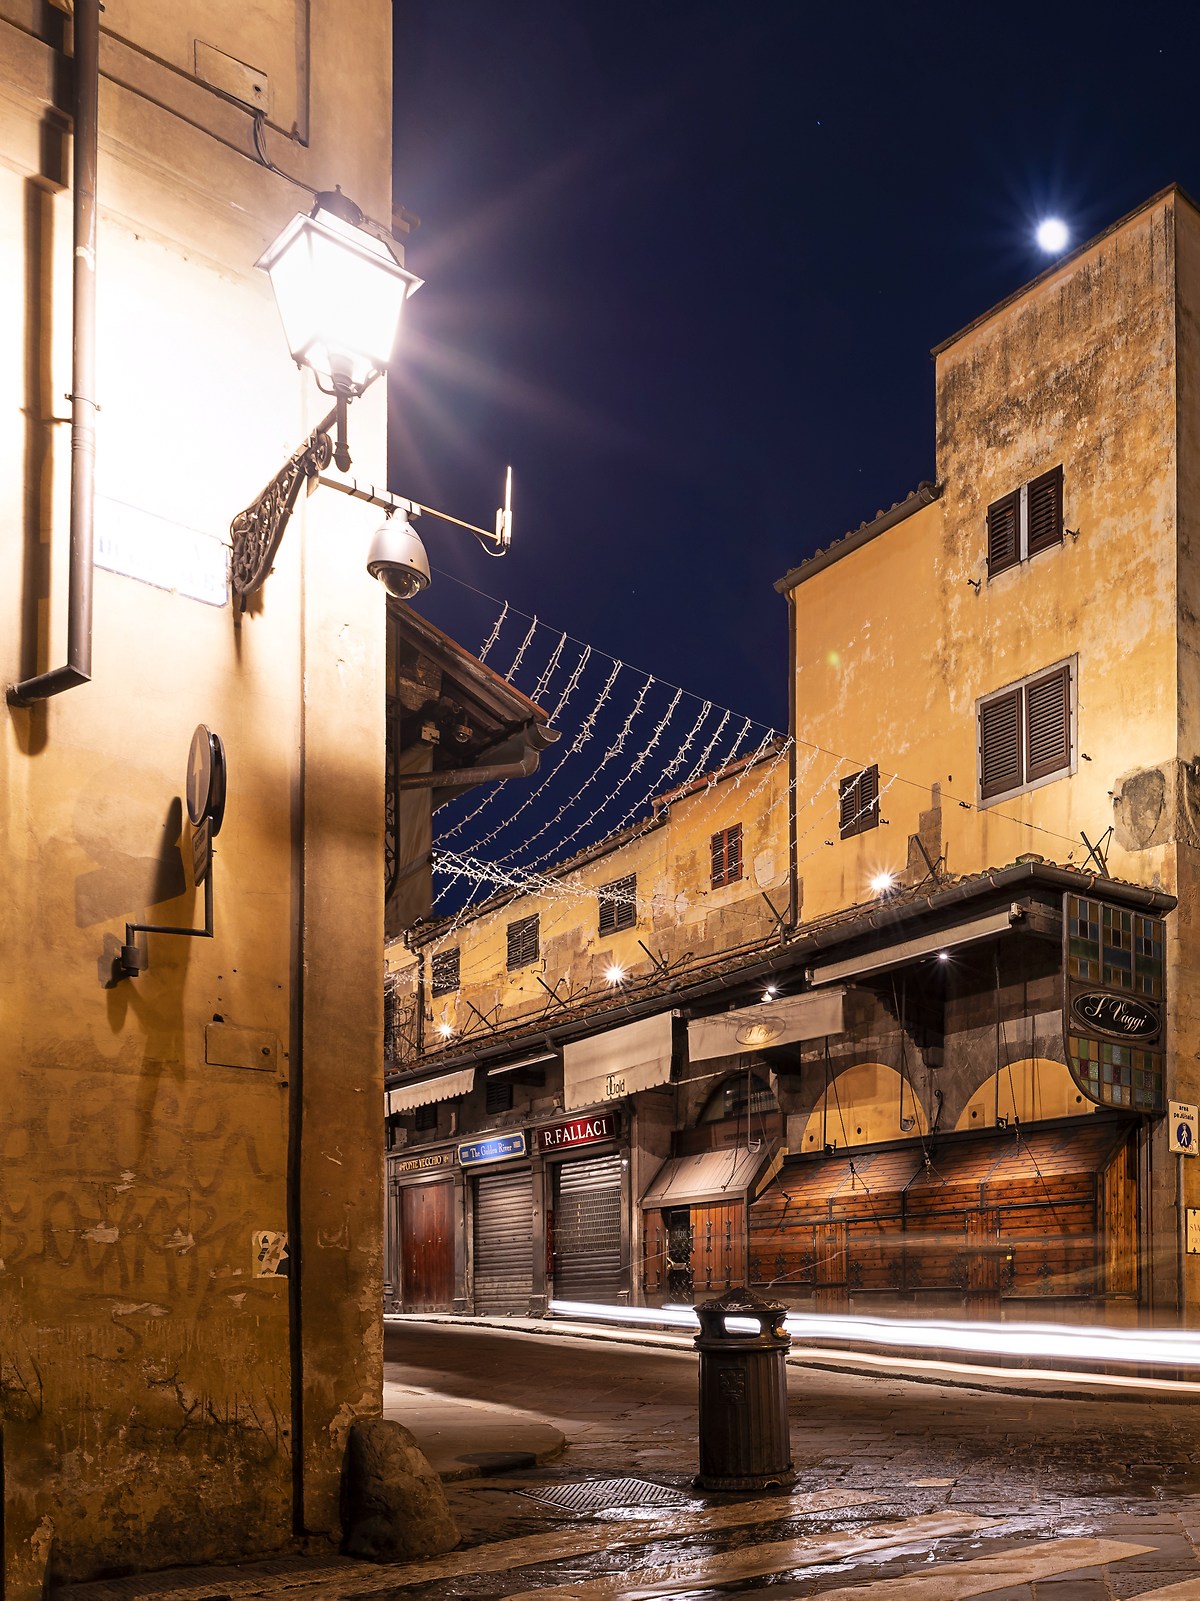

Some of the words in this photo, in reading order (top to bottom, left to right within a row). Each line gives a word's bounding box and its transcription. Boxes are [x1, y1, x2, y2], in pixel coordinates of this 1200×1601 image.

[1109, 1000, 1147, 1032] Vaggi
[544, 1119, 607, 1146] R.FALLACI
[469, 1147, 481, 1158] The
[480, 1144, 498, 1156] Golden
[497, 1142, 512, 1153] River
[418, 1155, 442, 1168] VECCHIO
